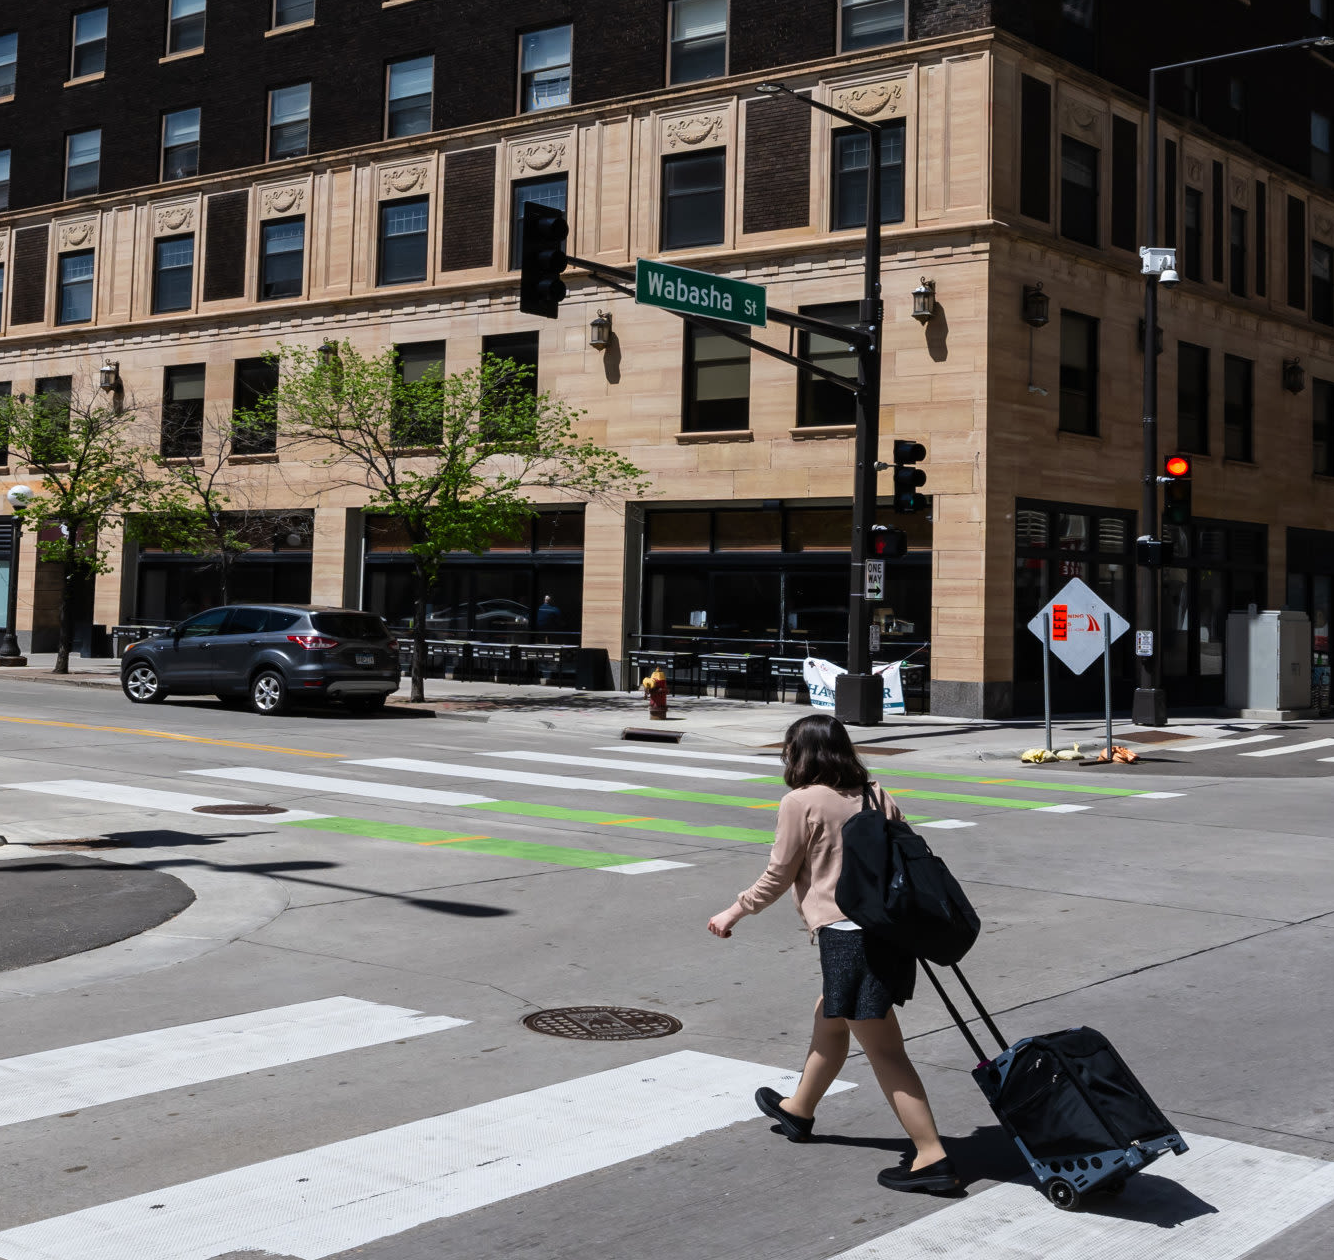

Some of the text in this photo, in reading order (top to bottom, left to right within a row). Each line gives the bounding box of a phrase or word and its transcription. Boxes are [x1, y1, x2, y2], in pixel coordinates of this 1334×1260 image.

[648, 270, 757, 316] Wabasha St
[868, 563, 882, 574] ONE
[868, 574, 882, 584] WAY
[1053, 607, 1067, 638] LEFT
